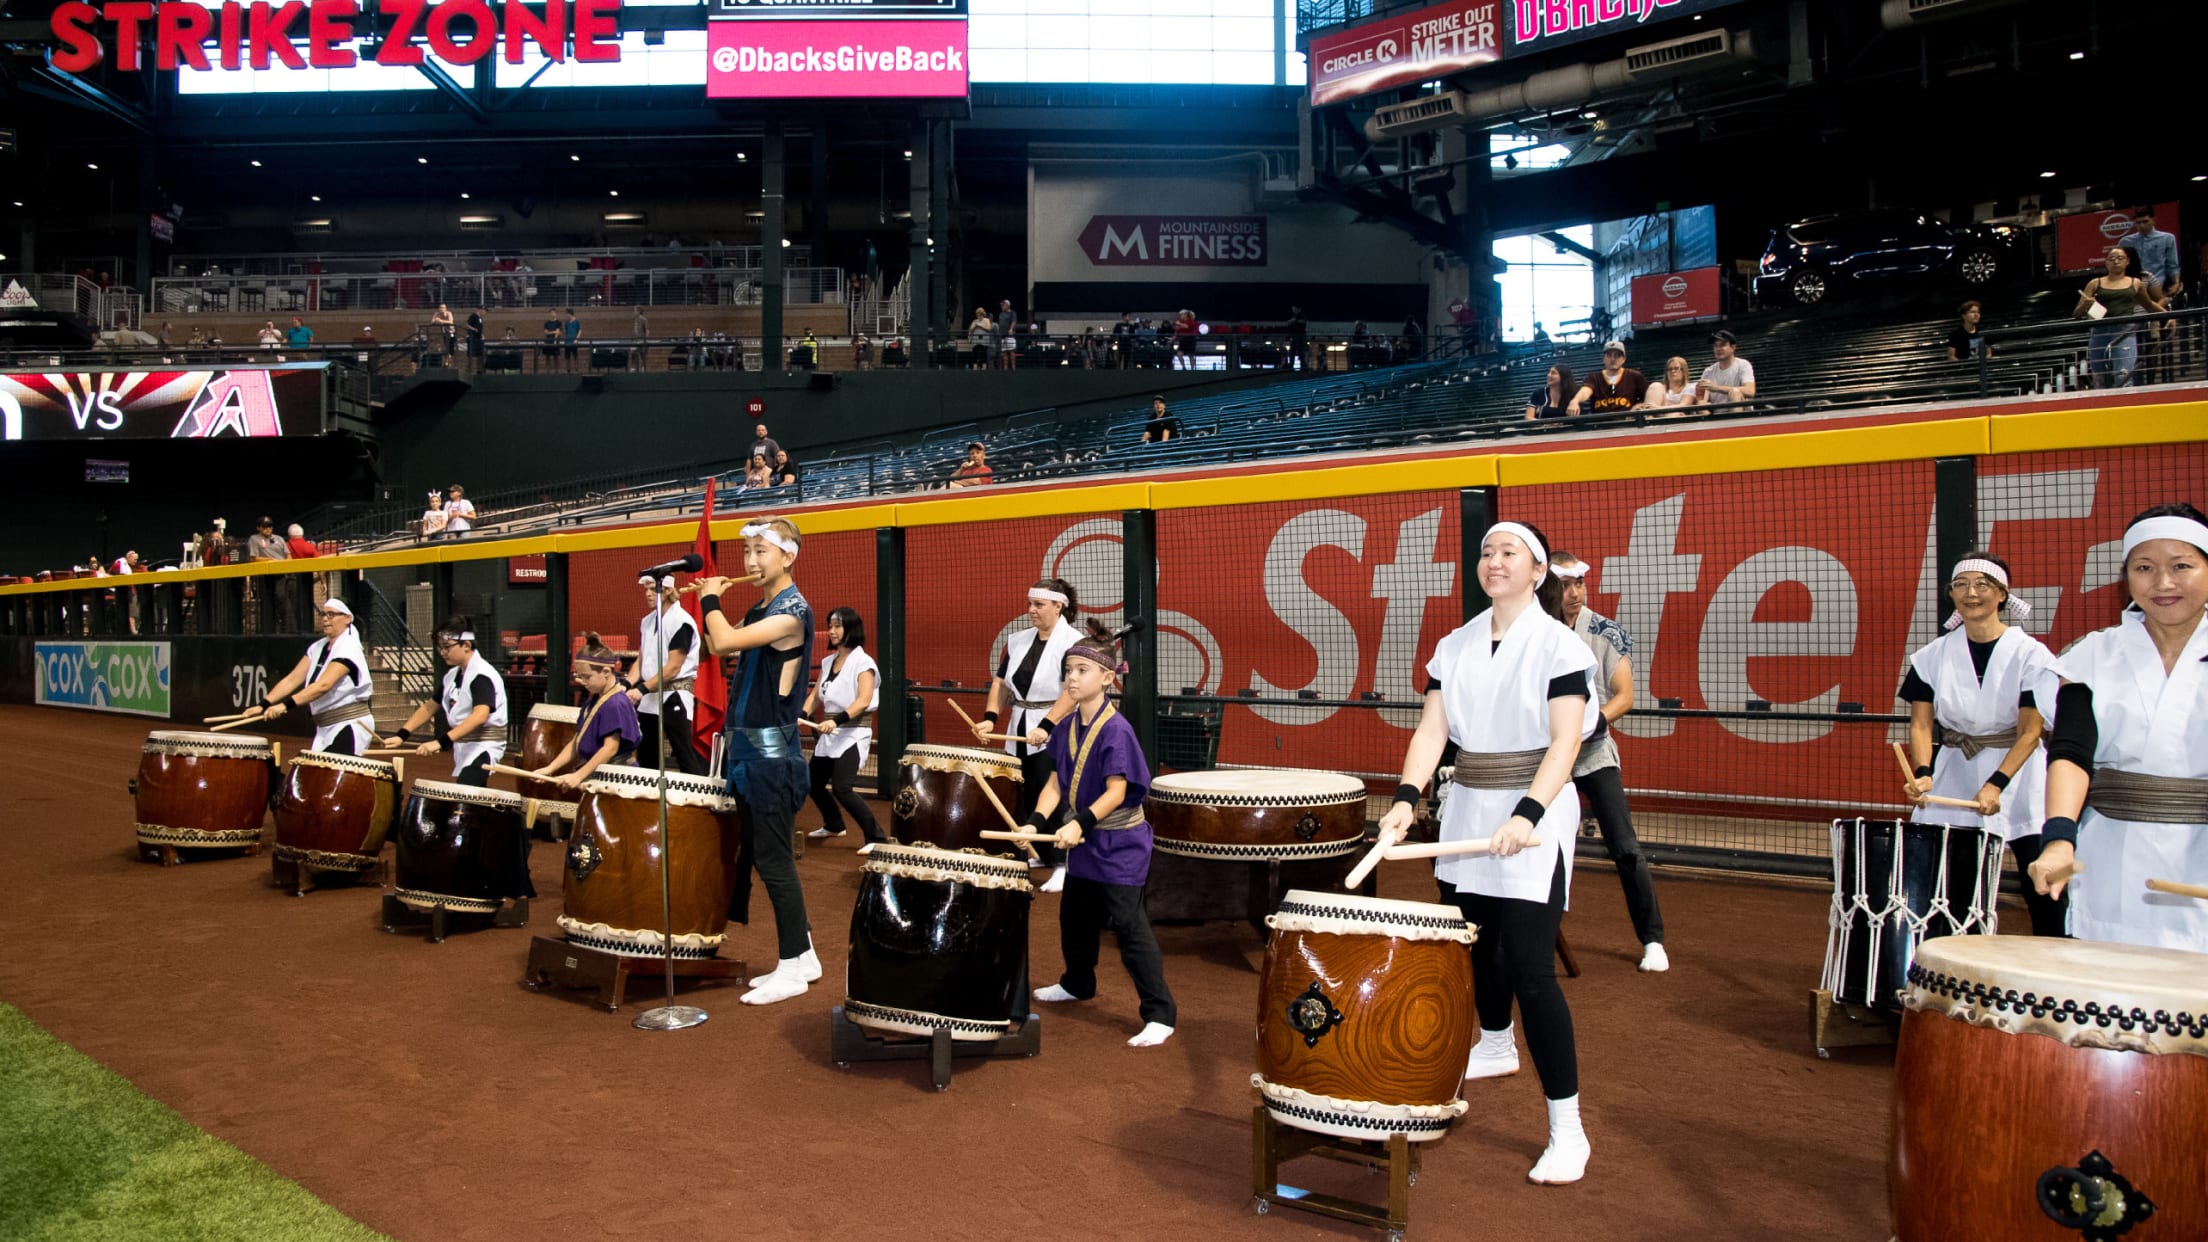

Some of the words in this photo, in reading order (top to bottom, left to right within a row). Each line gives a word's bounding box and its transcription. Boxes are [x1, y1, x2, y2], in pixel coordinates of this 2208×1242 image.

[51, 1, 359, 72] STRIKE
[376, 0, 622, 66] ZONE
[1411, 13, 1460, 40] STRIKE
[1464, 4, 1495, 25] OUT
[712, 45, 963, 73] @DbacksGiveBack
[1323, 48, 1374, 74] CIRCLE
[1377, 40, 1398, 62] K
[1411, 22, 1496, 64] METER
[1159, 222, 1261, 234] MOUNTAINSIDE
[1159, 234, 1262, 260] FITNESS
[66, 391, 124, 431] VS
[750, 403, 762, 412] 101
[47, 652, 85, 694] COX
[107, 653, 152, 699] COX
[232, 664, 268, 707] 376
